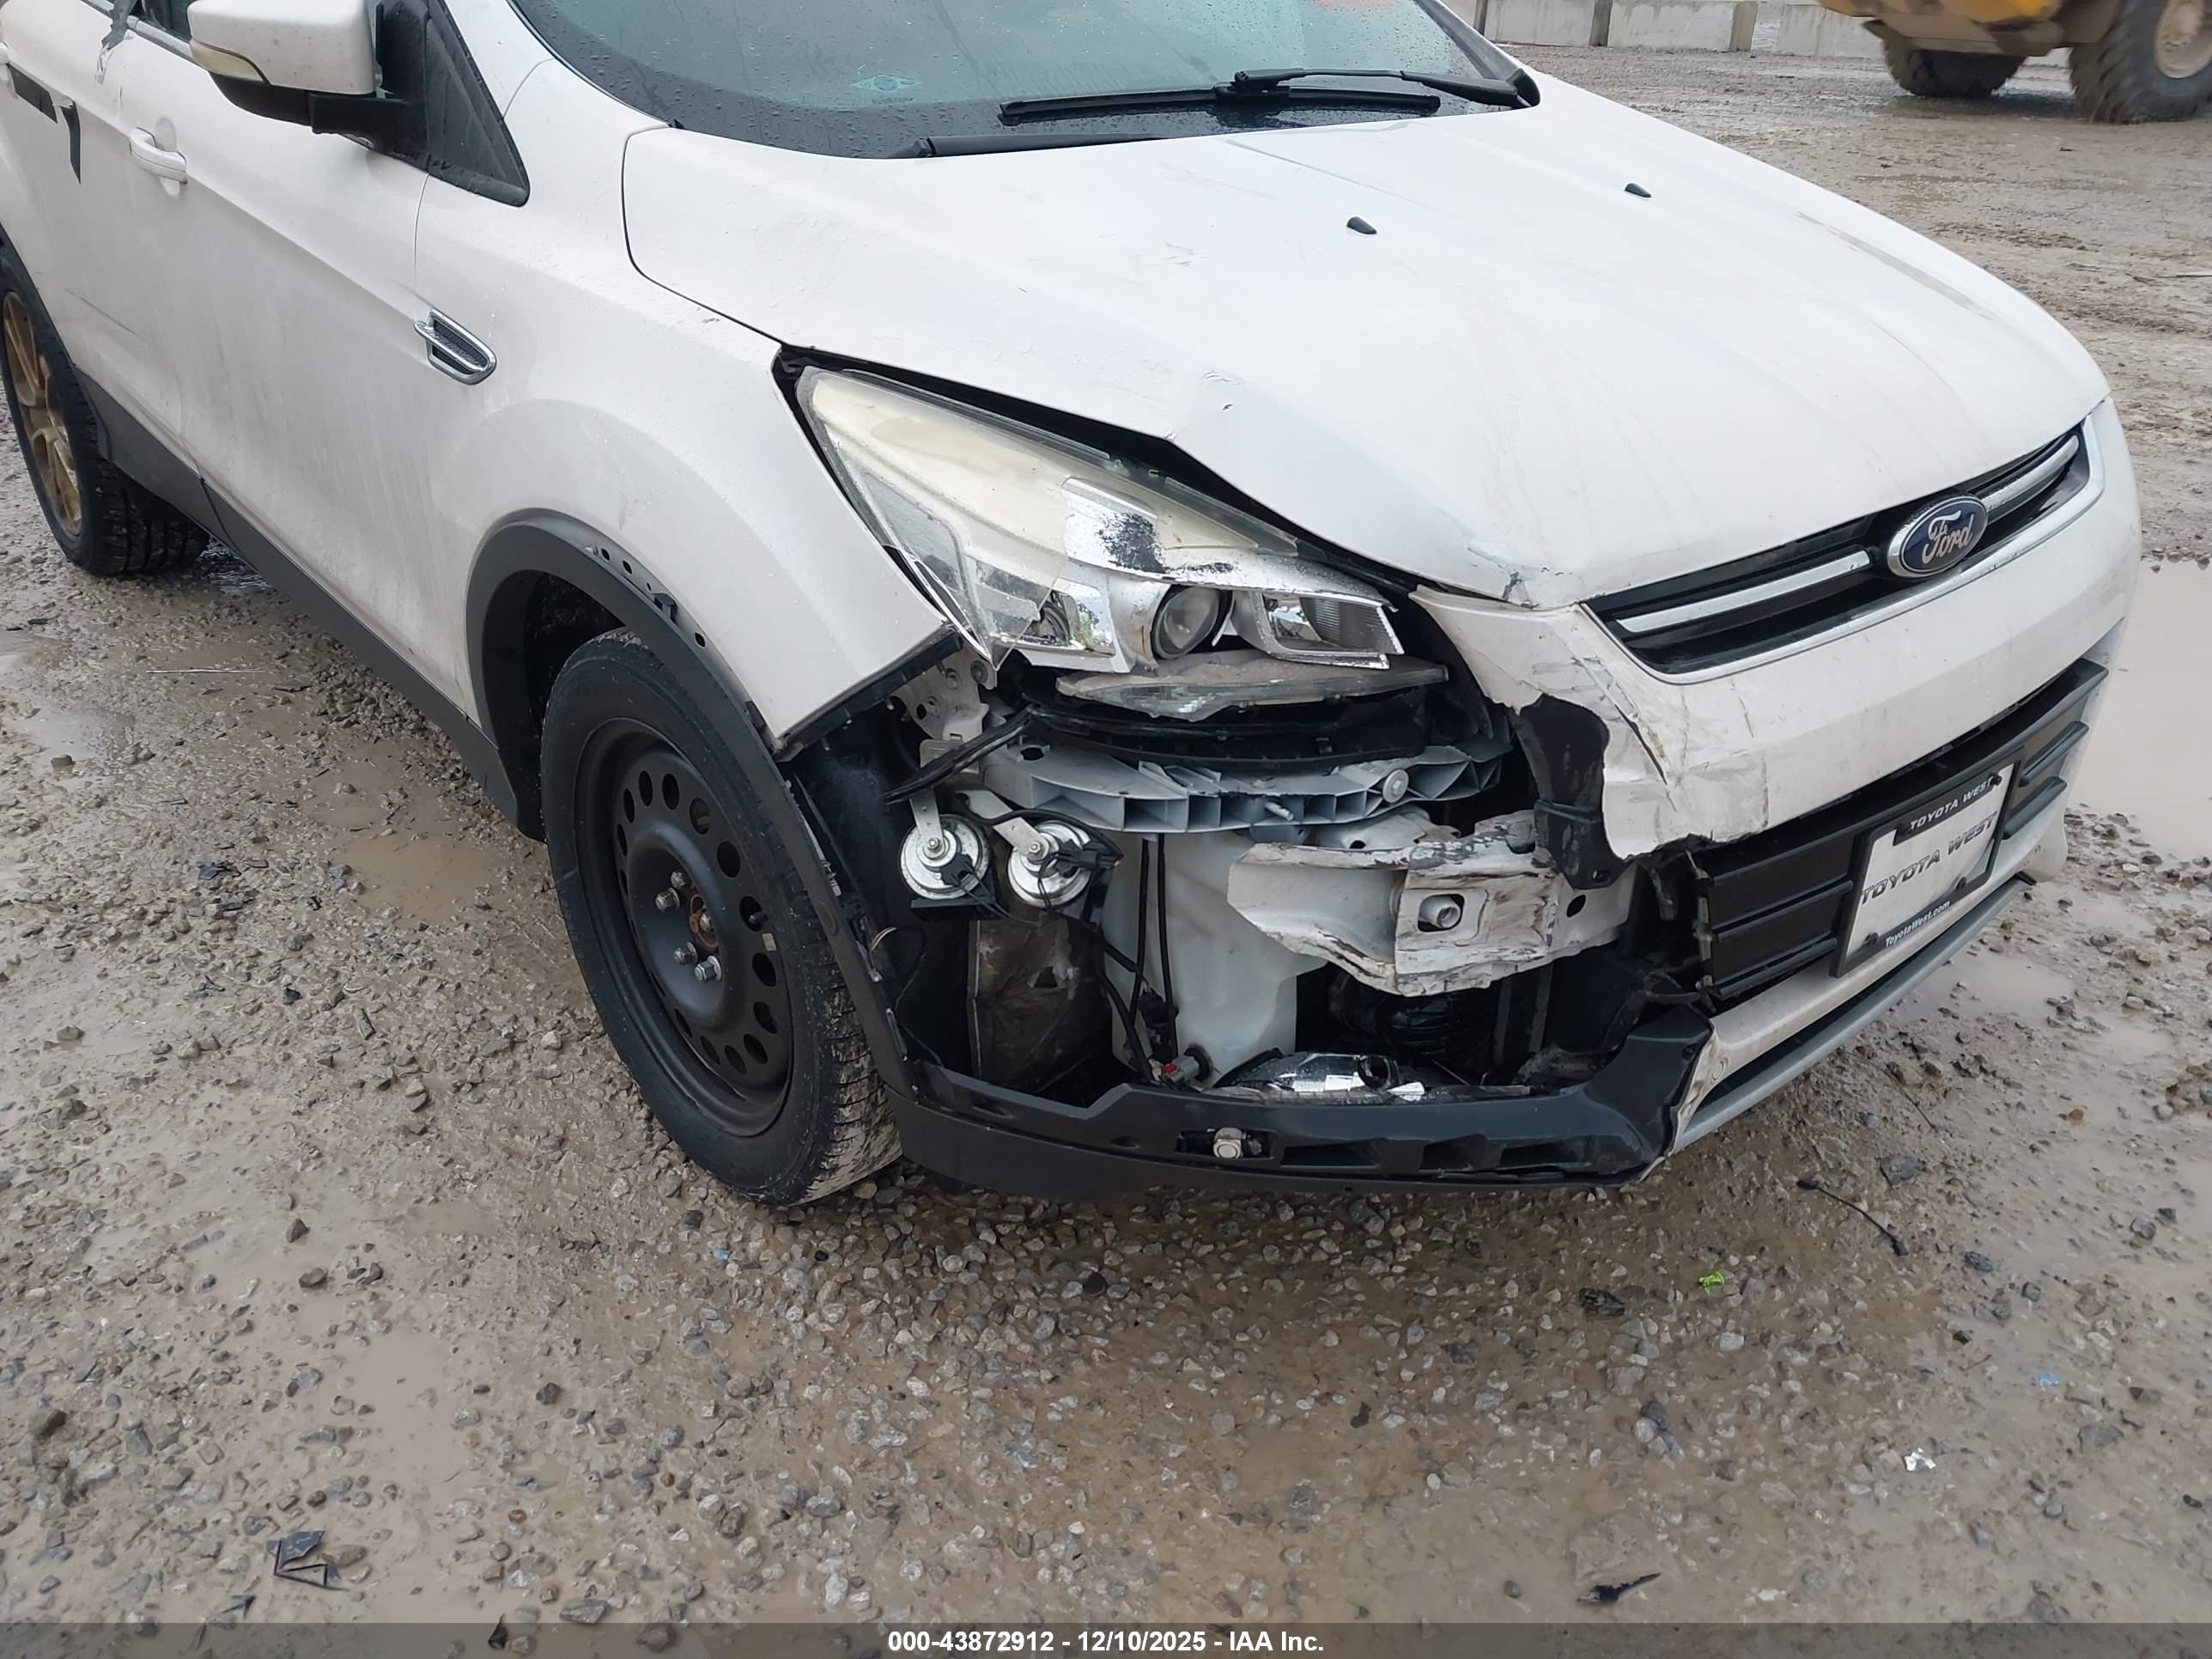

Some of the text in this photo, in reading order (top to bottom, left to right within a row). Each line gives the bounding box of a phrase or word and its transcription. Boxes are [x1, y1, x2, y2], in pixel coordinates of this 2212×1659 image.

[1922, 510, 1974, 563] Ford
[1909, 775, 1994, 831] TOYOTA WEST
[1862, 811, 1998, 905] TOYOTA WEST
[1885, 901, 1951, 947] ToyotaWest.com
